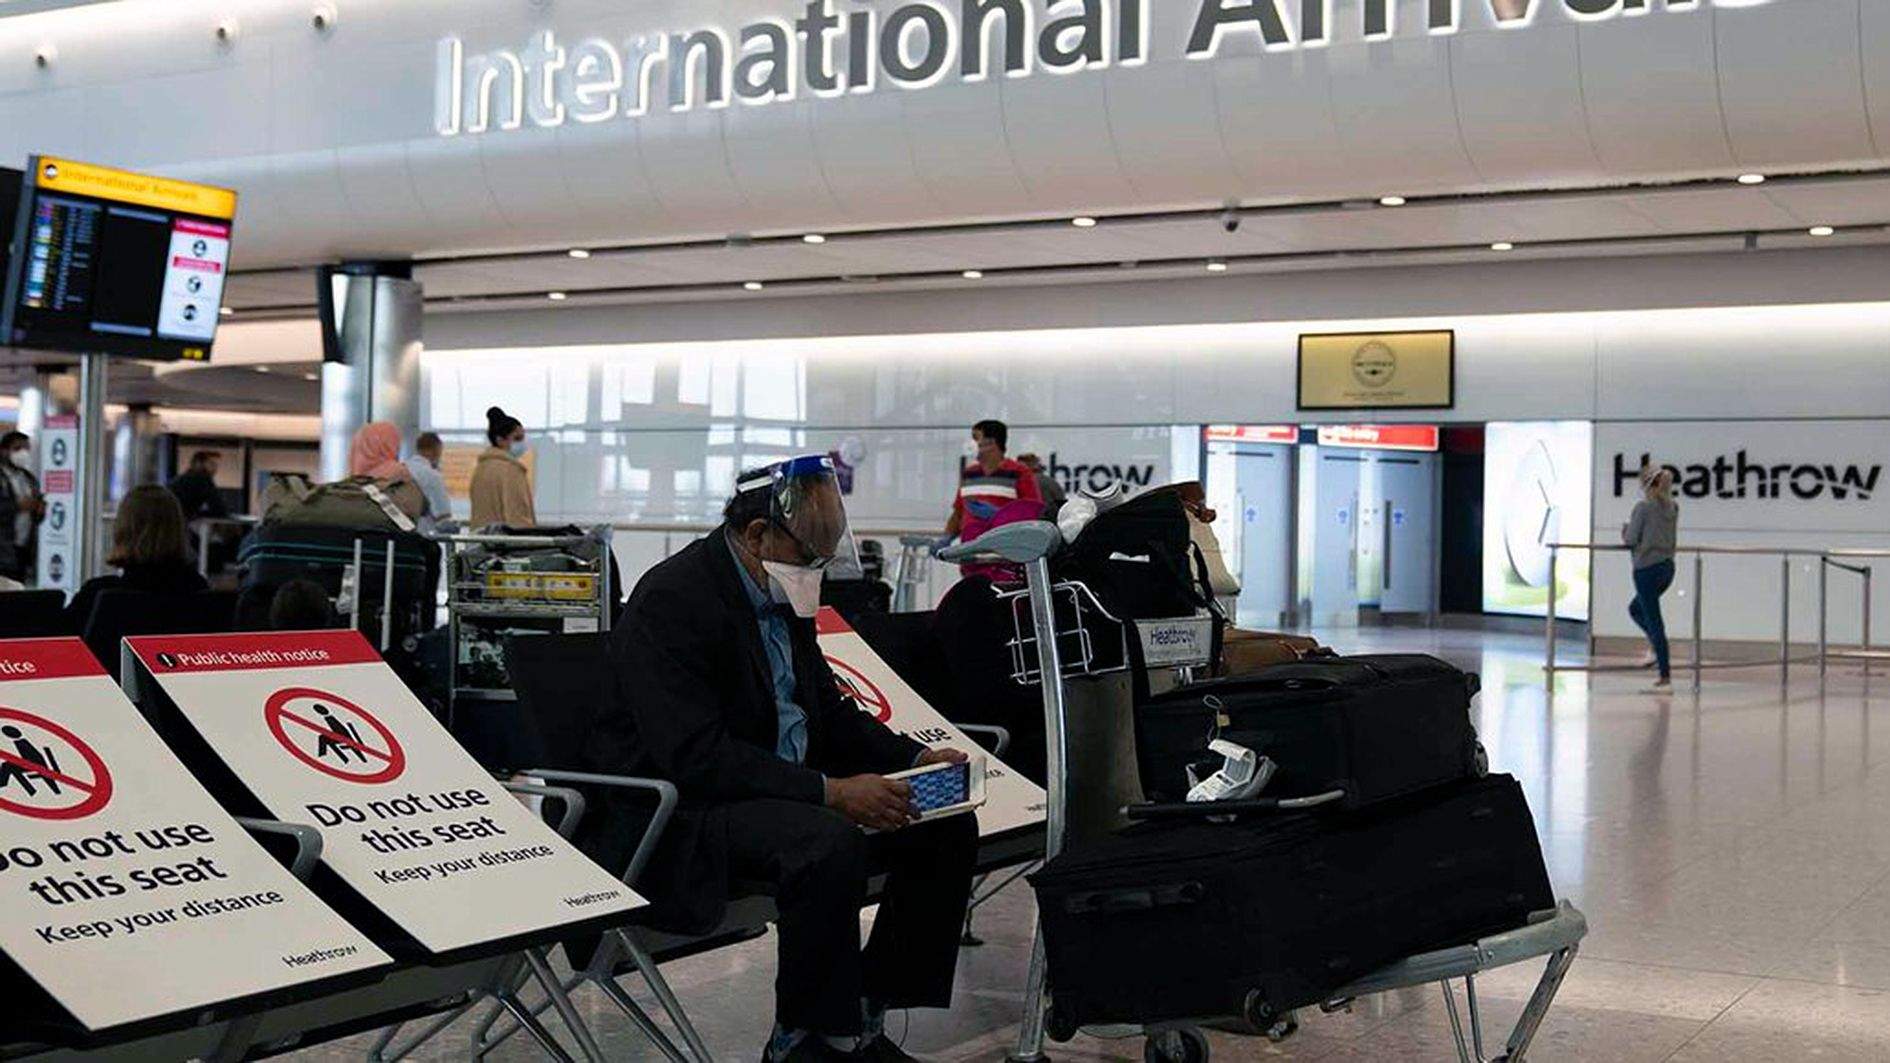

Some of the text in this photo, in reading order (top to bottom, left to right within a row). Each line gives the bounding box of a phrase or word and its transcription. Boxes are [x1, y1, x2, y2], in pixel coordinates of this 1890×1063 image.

[434, 0, 1148, 136] International
[0, 660, 36, 674] tice
[178, 647, 331, 667] Public health notice
[913, 727, 952, 743] use
[306, 787, 490, 827] Do not use
[48, 831, 136, 863] not
[135, 823, 215, 850] use
[361, 815, 506, 853] this seat
[29, 856, 228, 905] this seat
[374, 844, 554, 884] Keep your distance
[35, 889, 285, 944] Keep your distance
[563, 890, 621, 908] Heathrow
[281, 945, 358, 968] Heathrow
